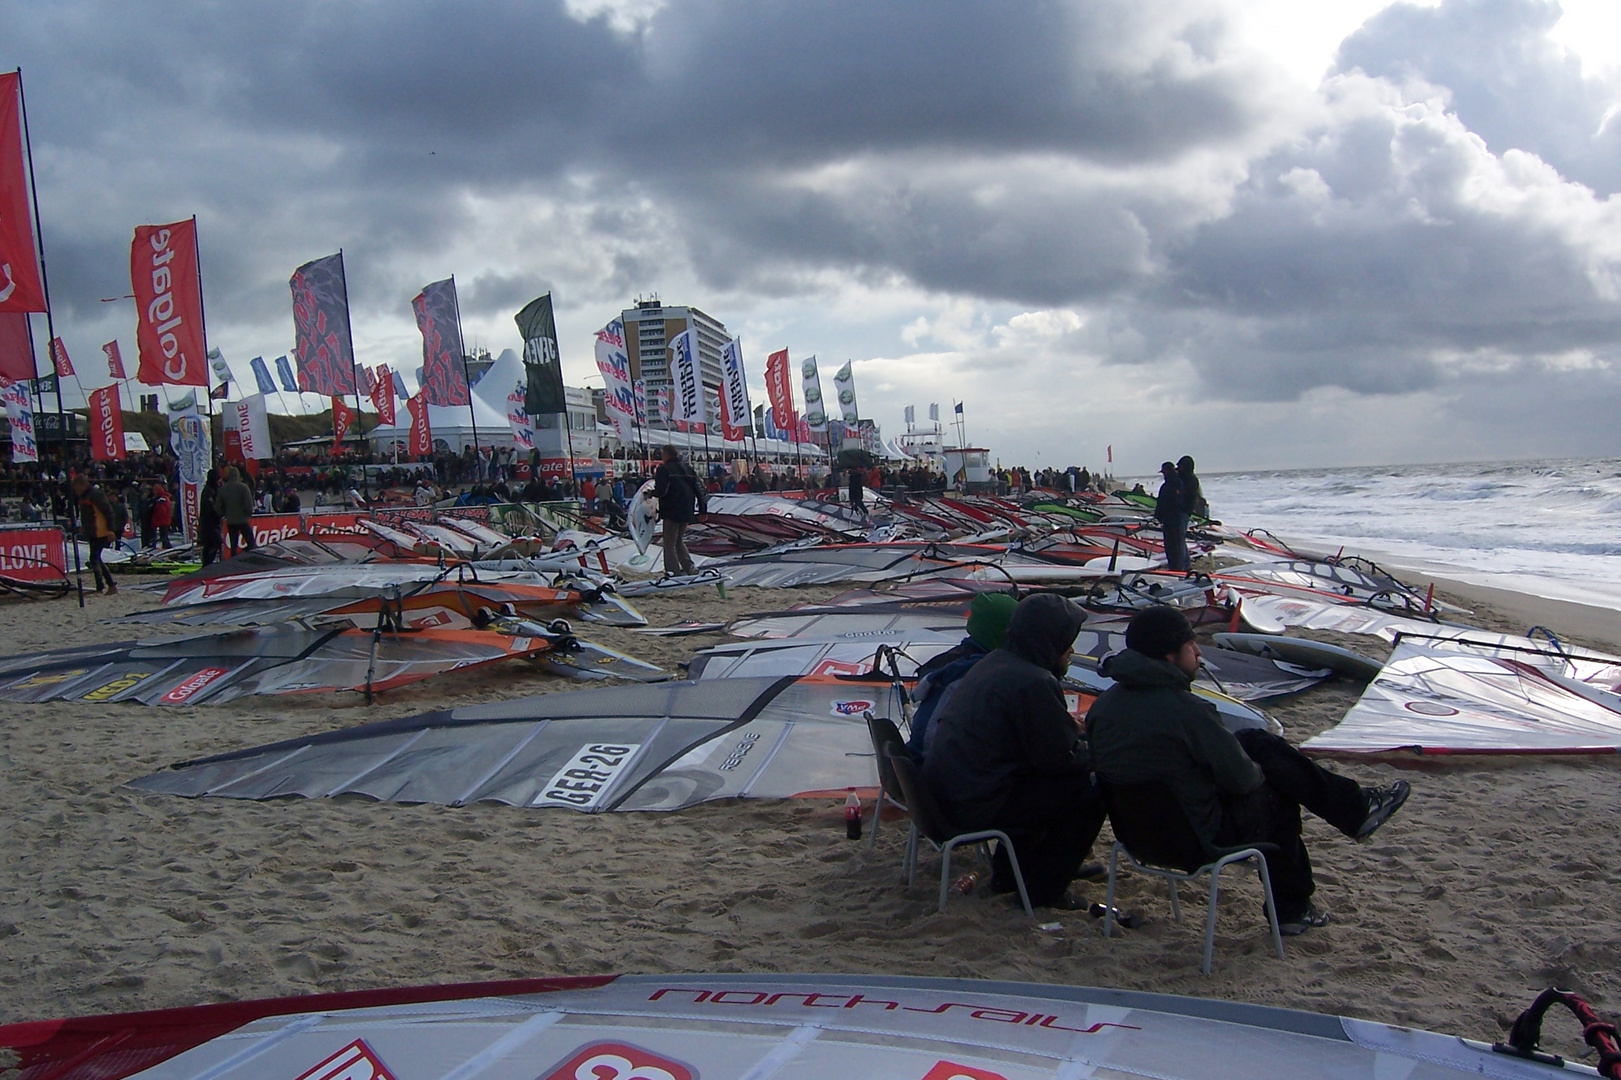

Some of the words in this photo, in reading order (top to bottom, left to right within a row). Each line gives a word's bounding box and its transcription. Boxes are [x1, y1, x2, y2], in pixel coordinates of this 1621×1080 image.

[515, 461, 563, 473] Coate
[187, 489, 199, 543] olgate
[0, 544, 48, 570] LOVE
[168, 669, 221, 700] Colgate
[545, 744, 631, 804] GER-26
[648, 989, 899, 1010] north
[903, 1003, 1142, 1033] sails
